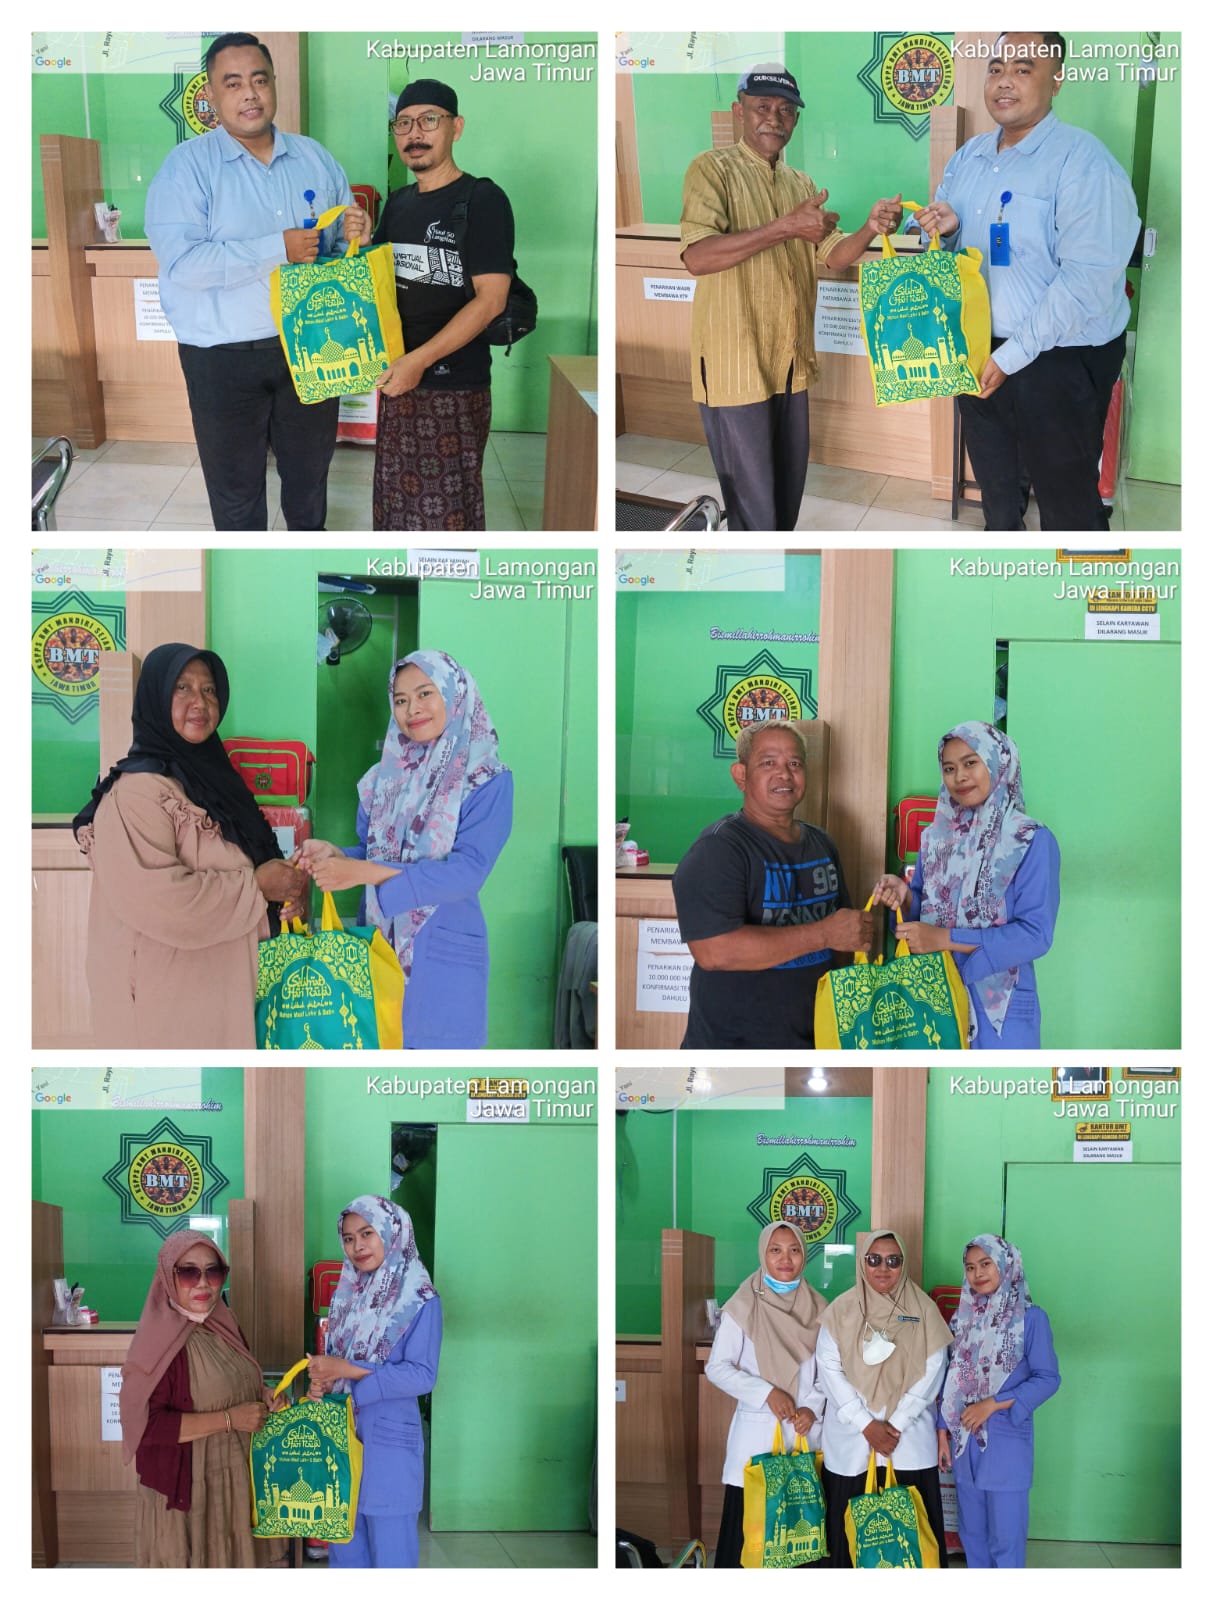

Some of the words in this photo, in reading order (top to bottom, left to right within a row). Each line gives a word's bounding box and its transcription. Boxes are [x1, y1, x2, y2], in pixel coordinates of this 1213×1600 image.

[885, 65, 893, 91] KSPPS
[889, 47, 902, 63] BMT
[902, 39, 936, 48] MANDIRI
[936, 47, 952, 90] SEJAHTERA
[896, 68, 940, 83] BMT
[897, 99, 914, 110] JAWA
[916, 99, 937, 110] TIMUR
[55, 617, 94, 628] MANDIRI
[38, 623, 54, 640] BMT
[95, 627, 111, 651] SEJAH
[35, 641, 43, 669] KSPPS
[49, 647, 99, 664] BMT
[50, 679, 70, 691] JAWA
[71, 681, 96, 692] TIMUR
[727, 702, 736, 727] KSPPS
[734, 686, 746, 700] BMT
[747, 679, 783, 690] MANDIRI
[782, 688, 799, 722] SEJAHTE
[740, 706, 786, 720] BMT
[812, 863, 839, 895] 96
[646, 926, 680, 934] PENARIKA
[662, 994, 688, 1002] DAHULU
[132, 1169, 140, 1194] KSPPS
[136, 1153, 150, 1168] BMT
[150, 1147, 184, 1157] MANDIRI
[143, 1173, 189, 1188] BMT
[777, 1185, 789, 1199] BMT
[790, 1179, 820, 1189] MANDIRI
[146, 1201, 164, 1213] JAWA
[165, 1203, 187, 1214] TIMUR
[784, 1203, 825, 1218] BMT
[806, 1231, 821, 1240] IMUR
